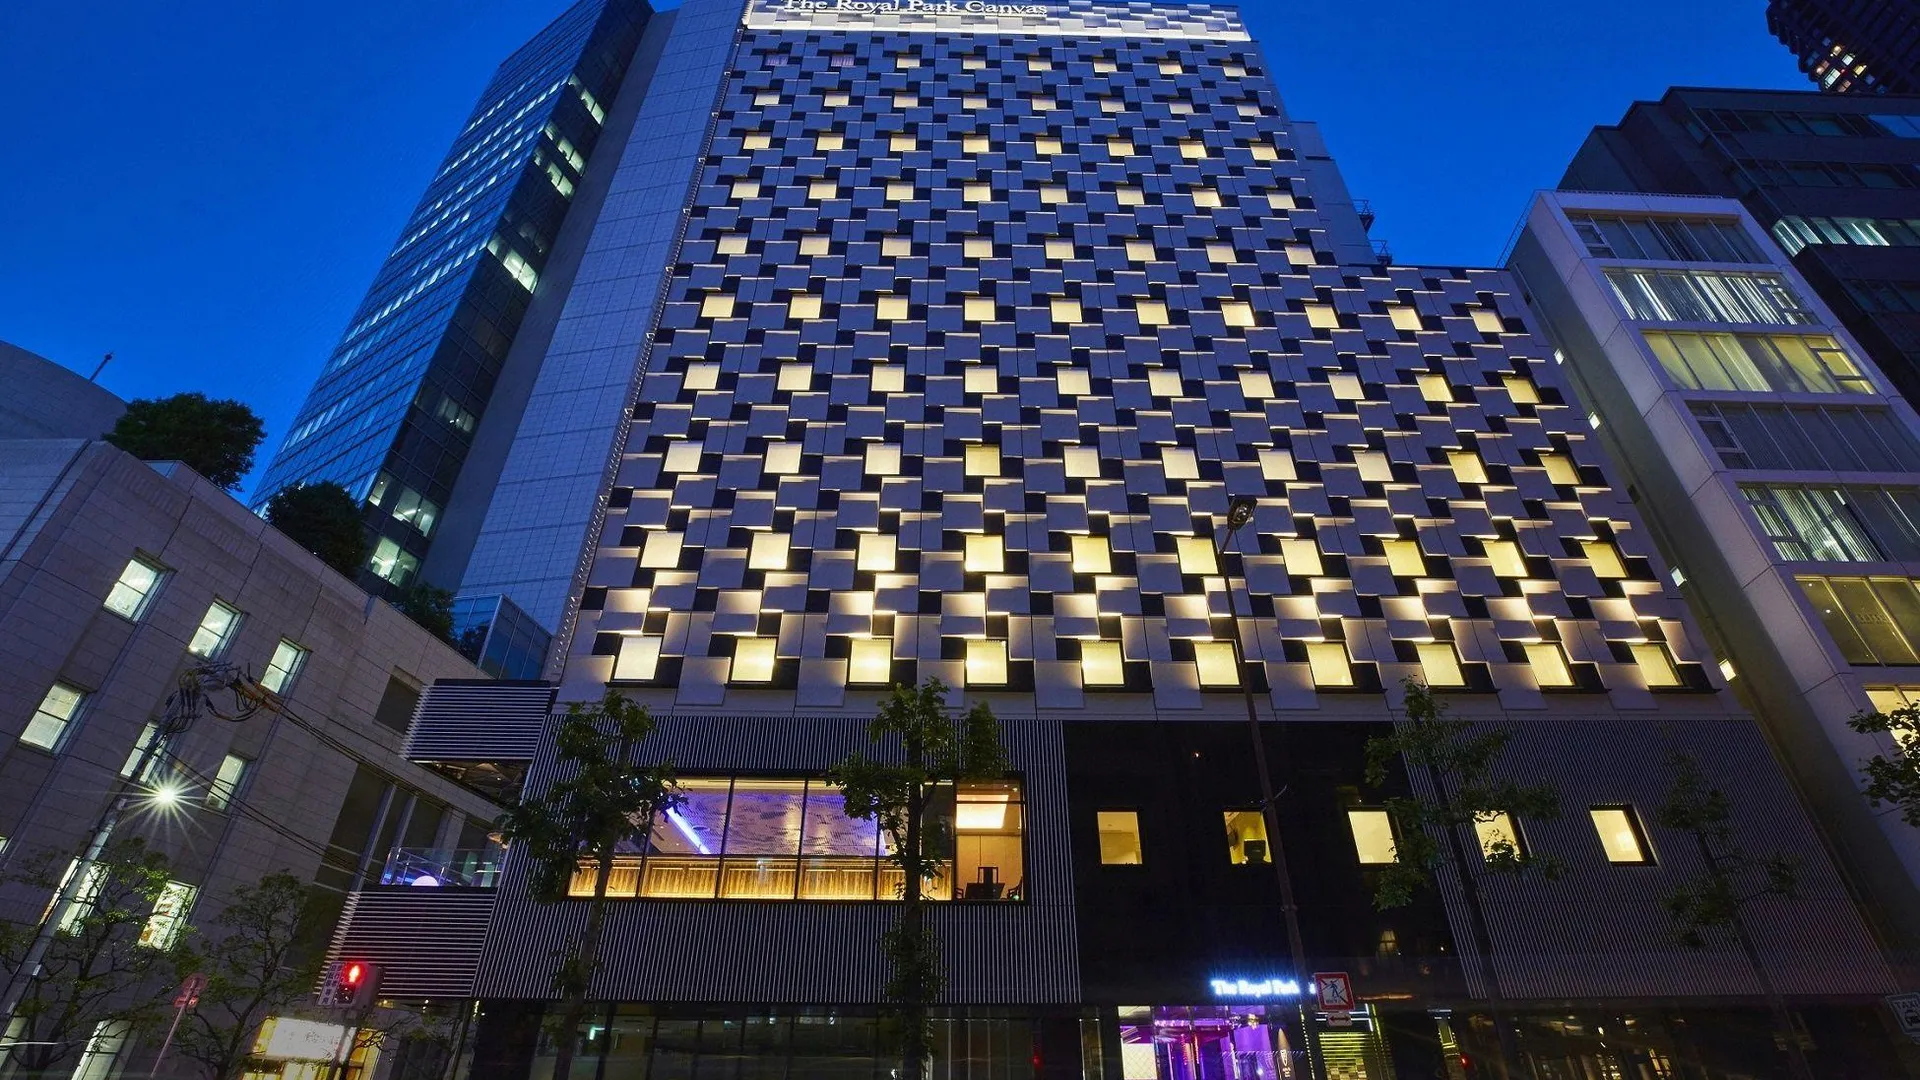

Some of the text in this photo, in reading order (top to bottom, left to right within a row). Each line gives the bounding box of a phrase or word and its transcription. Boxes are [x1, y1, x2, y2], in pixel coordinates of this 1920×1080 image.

[834, 0, 900, 14] Royal
[907, 0, 958, 13] Park
[965, 1, 1048, 15] Canvas
